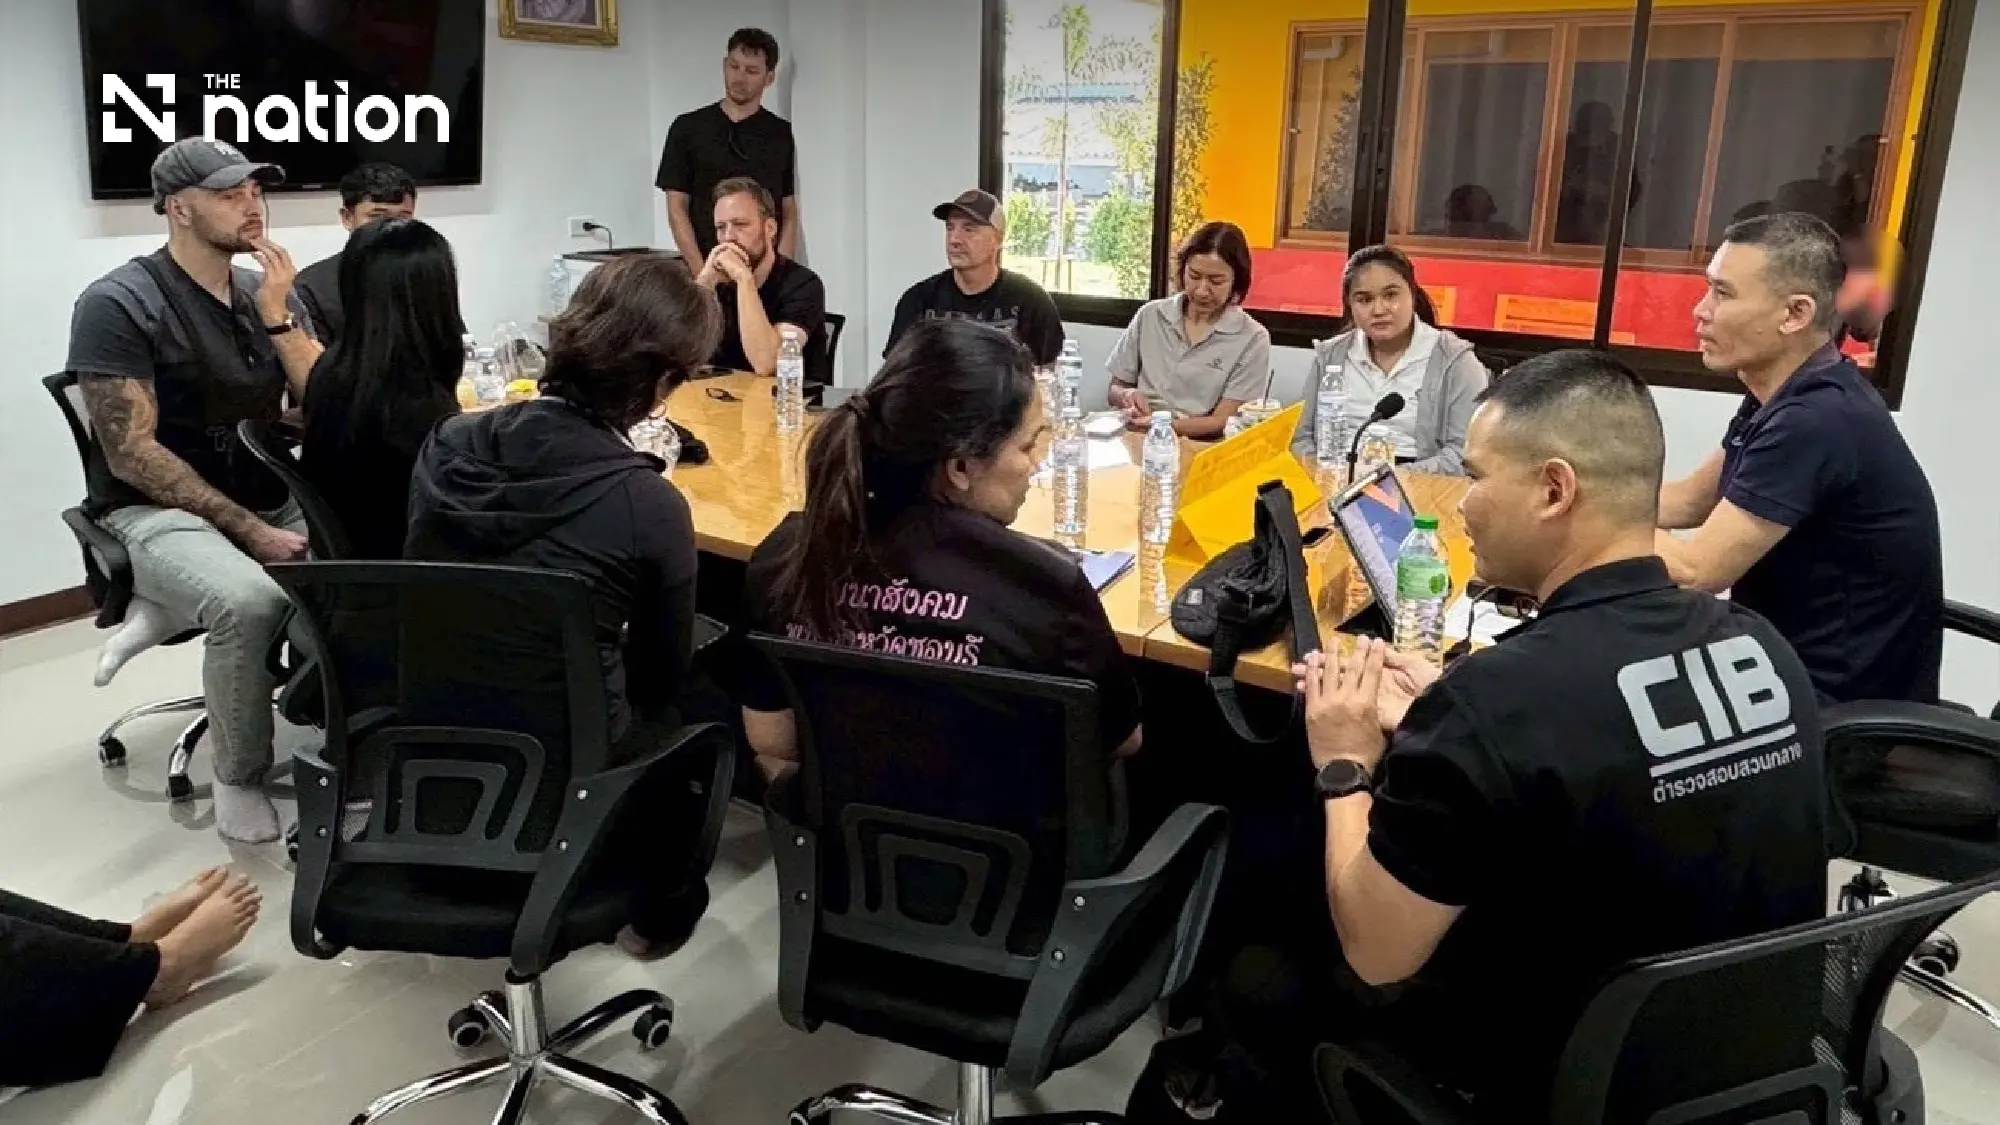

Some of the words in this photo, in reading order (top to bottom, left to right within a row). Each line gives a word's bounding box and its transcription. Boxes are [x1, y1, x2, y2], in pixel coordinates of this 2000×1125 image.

[1617, 633, 1791, 758] CIB
[1652, 742, 1804, 804] ตำรวจสอบสวนกลาง
